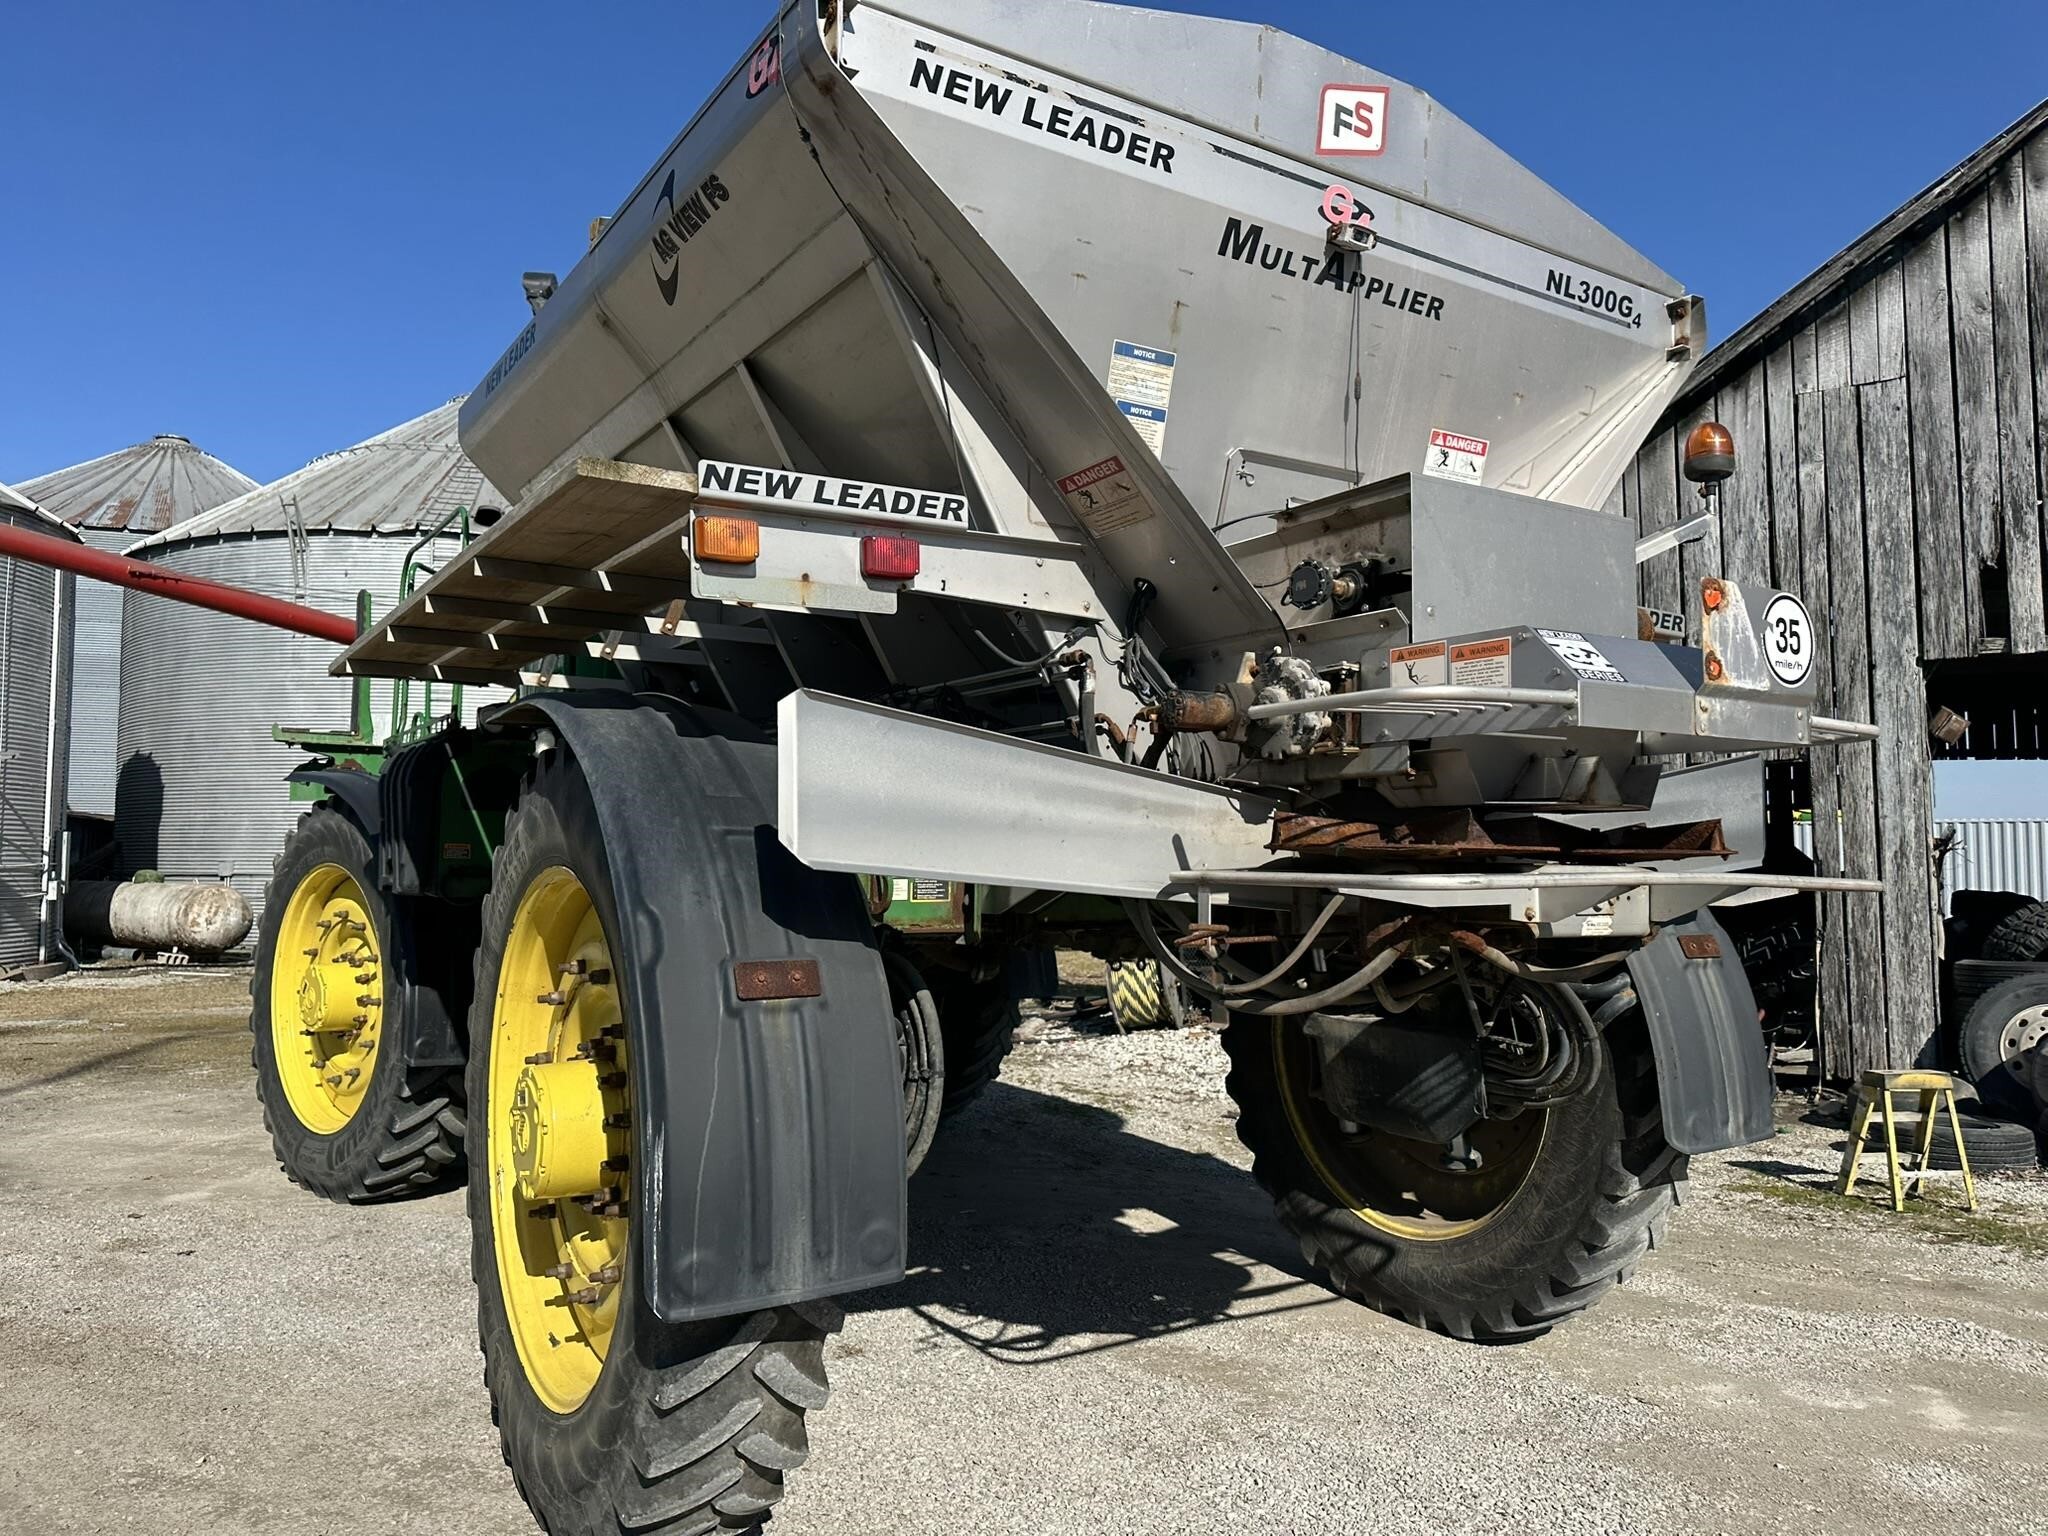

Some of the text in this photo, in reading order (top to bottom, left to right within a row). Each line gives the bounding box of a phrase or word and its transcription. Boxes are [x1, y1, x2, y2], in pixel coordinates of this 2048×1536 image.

[909, 57, 1175, 174] NEW LEADER
[1333, 101, 1373, 138] FS
[652, 174, 730, 264] AG VIEW FS
[503, 322, 536, 377] LEADER
[1133, 348, 1156, 360] NOTICE
[1130, 406, 1152, 417] NOTICE
[1445, 435, 1483, 454] DANGER
[1073, 460, 1119, 486] DANGER
[701, 463, 965, 522] NEW LEADER
[1775, 617, 1801, 655] 35
[1407, 645, 1440, 657] WARNING
[1468, 644, 1505, 656] WARNING
[1578, 669, 1625, 682] SERIES
[1775, 659, 1803, 671] mile/h
